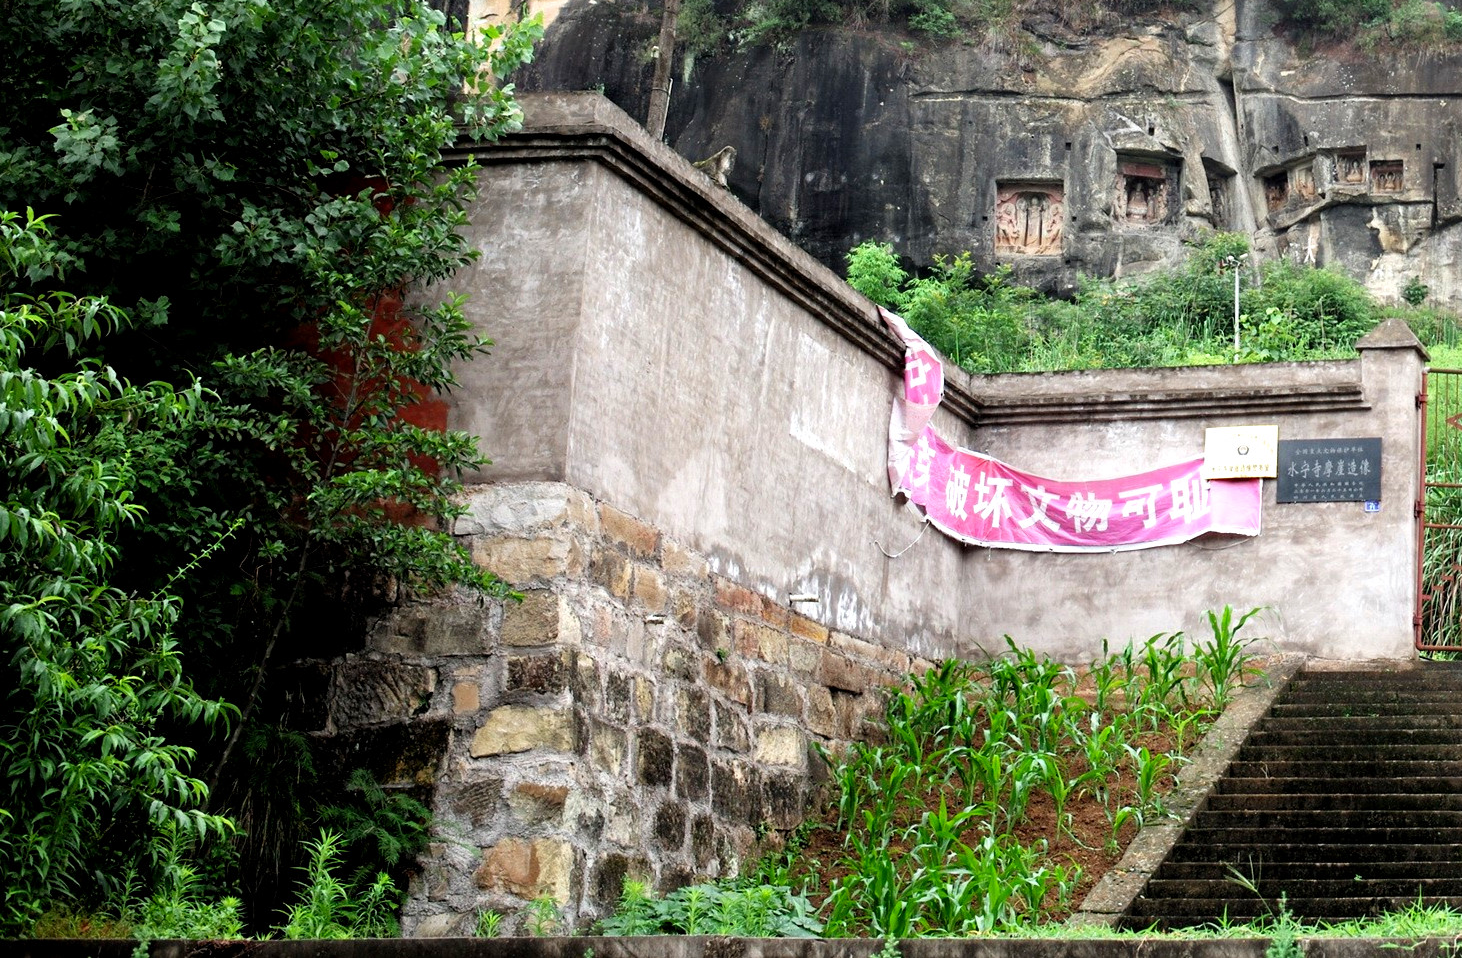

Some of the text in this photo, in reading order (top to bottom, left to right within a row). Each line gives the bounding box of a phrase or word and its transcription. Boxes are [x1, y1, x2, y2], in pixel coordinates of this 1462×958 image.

[1288, 459, 1371, 479] 水宁寺摩崖造像
